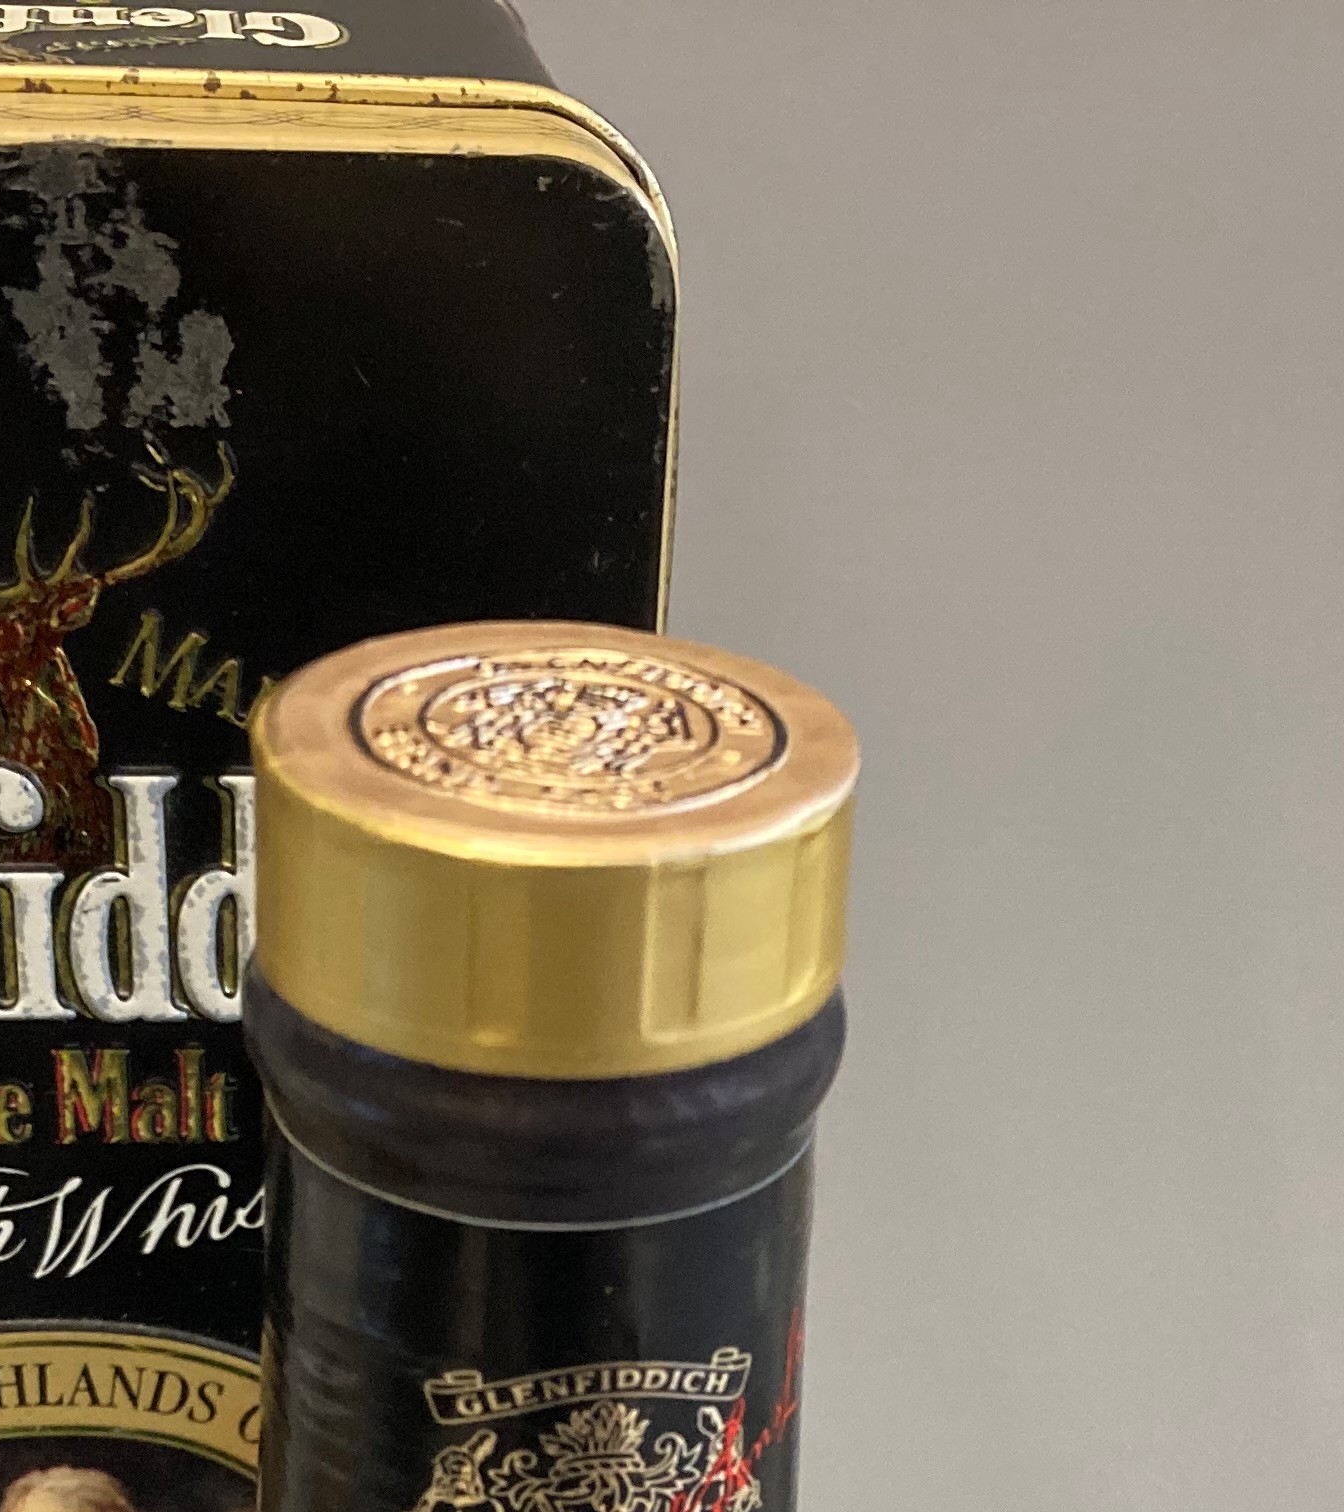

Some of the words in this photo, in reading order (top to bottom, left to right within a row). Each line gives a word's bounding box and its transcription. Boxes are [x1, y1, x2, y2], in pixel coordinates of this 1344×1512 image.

[52, 1043, 240, 1145] Malt
[6, 1163, 266, 1280] Whis
[455, 1368, 730, 1417] GLENFIDDICH
